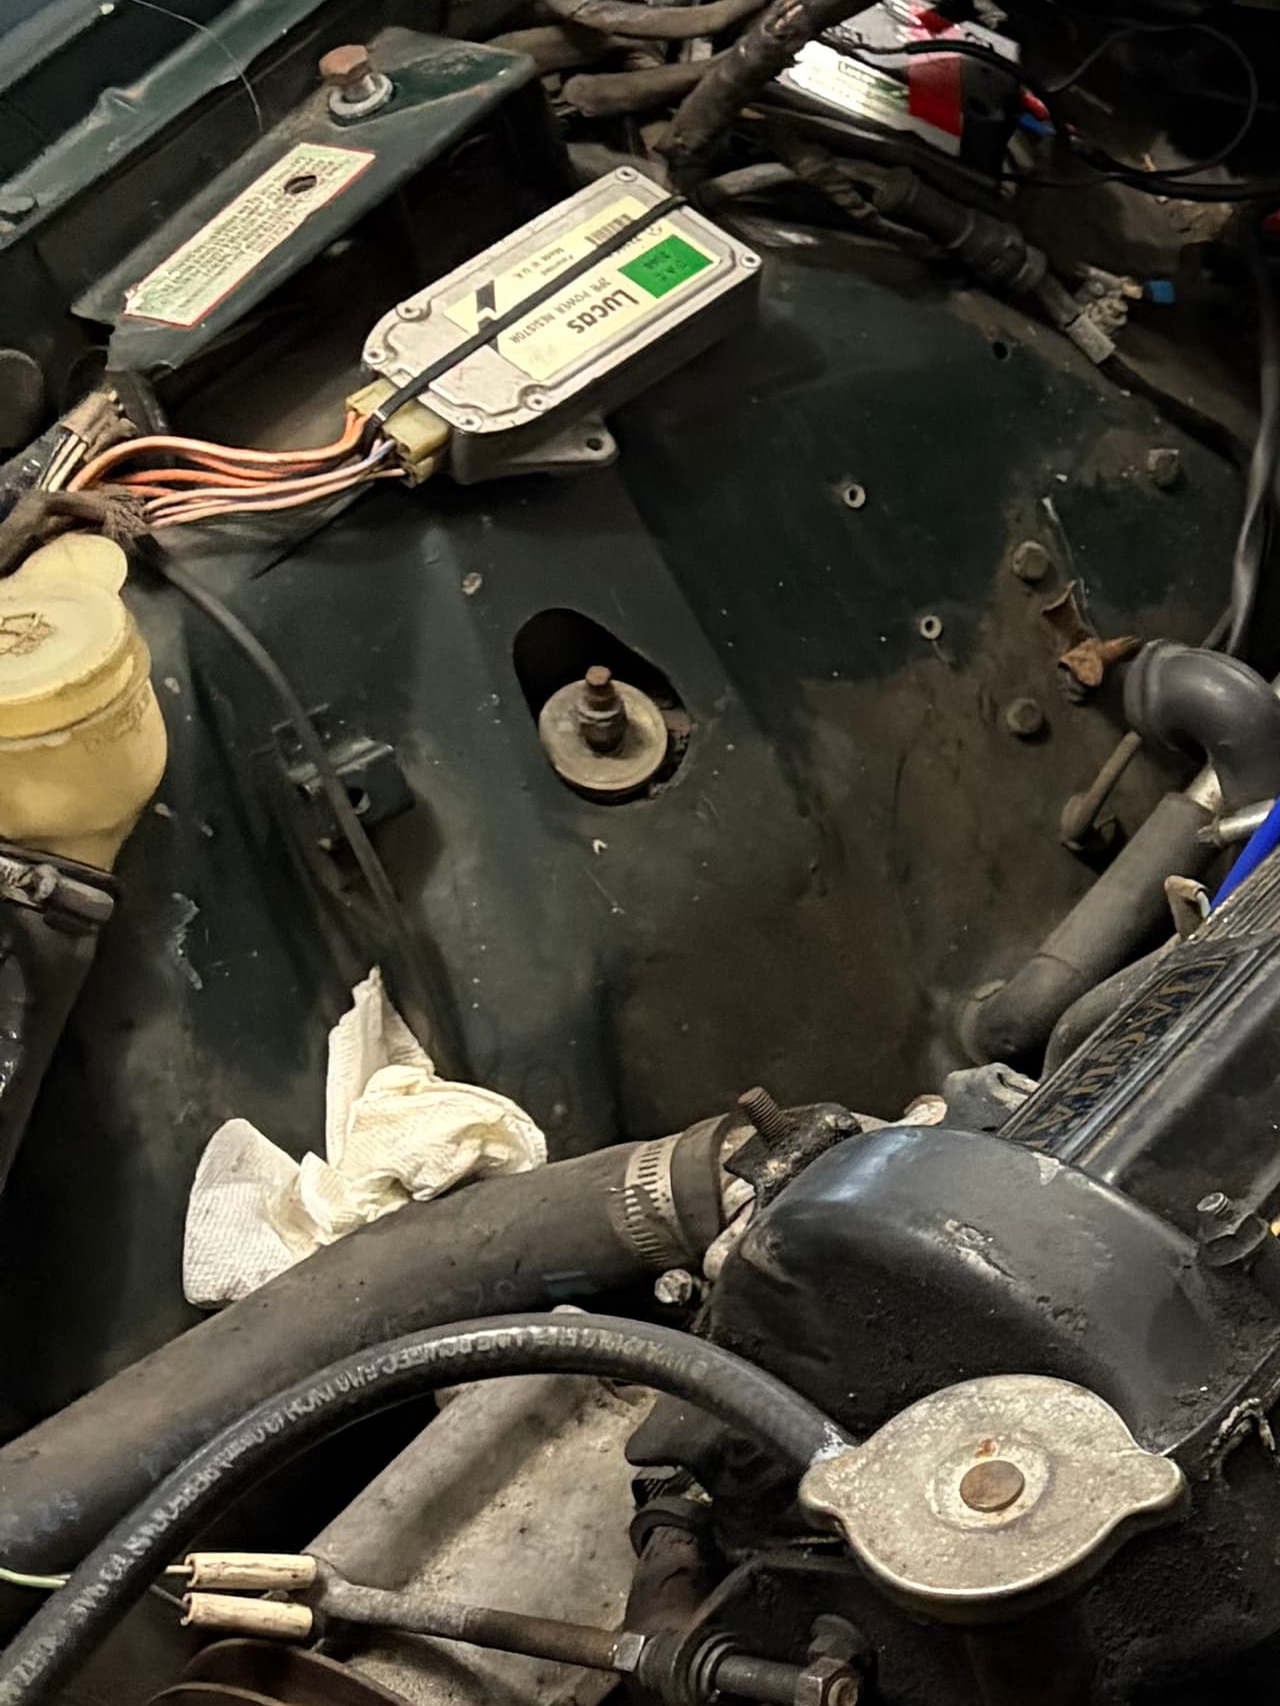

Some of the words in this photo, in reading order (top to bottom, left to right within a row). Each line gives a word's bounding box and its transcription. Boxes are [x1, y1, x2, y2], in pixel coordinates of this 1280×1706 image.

[554, 291, 592, 316] POWER
[565, 288, 639, 335] Lucas
[508, 310, 556, 344] RESISTOR
